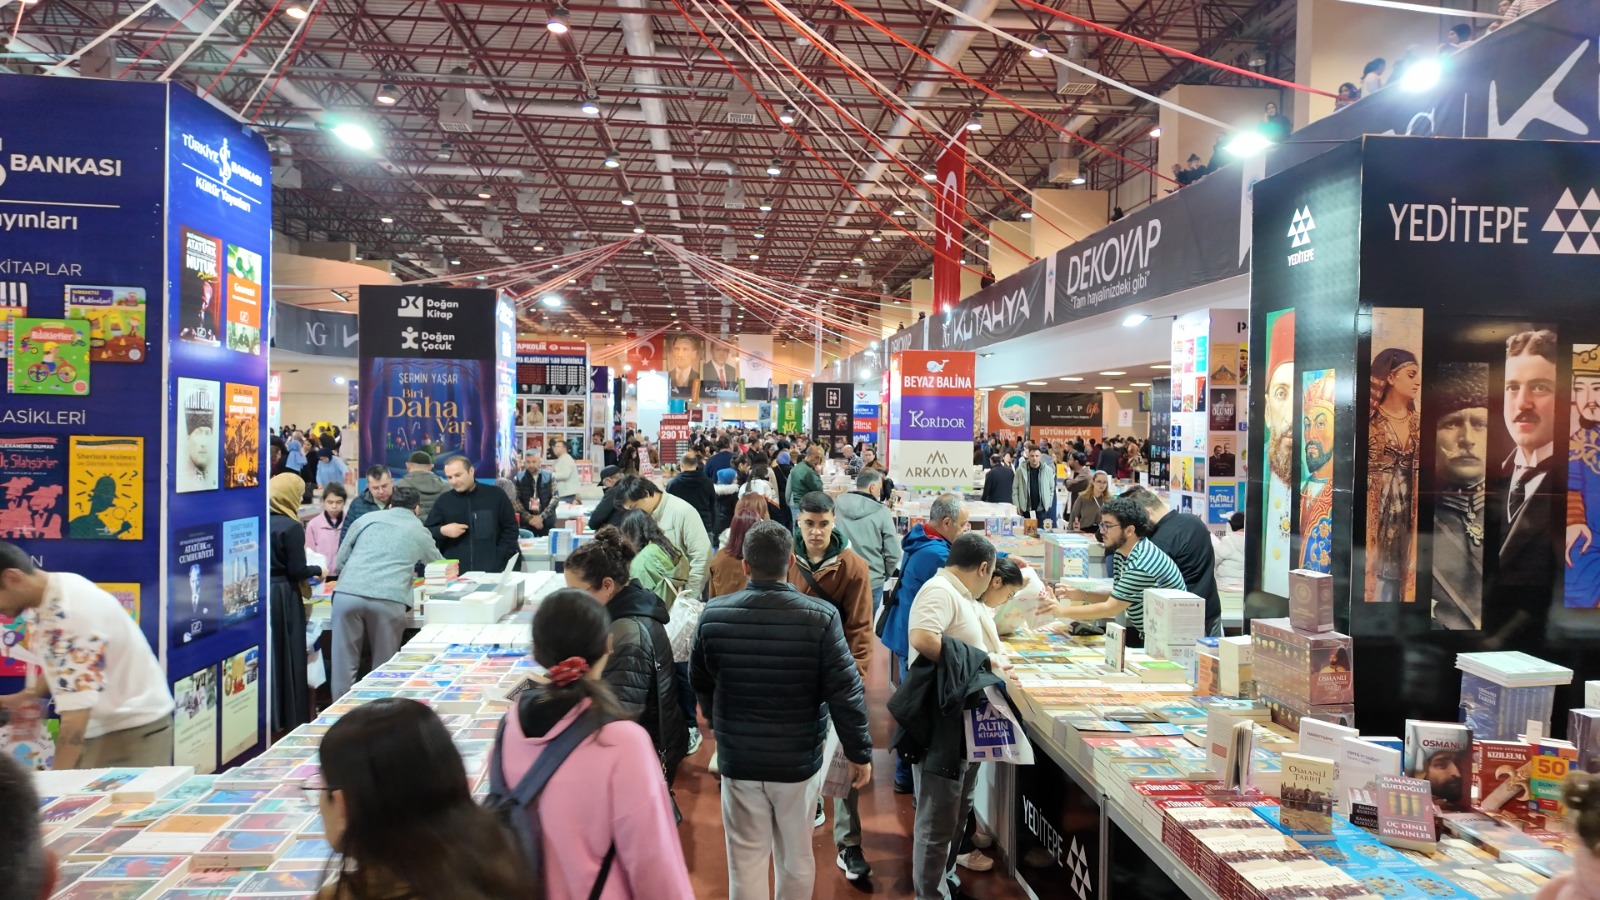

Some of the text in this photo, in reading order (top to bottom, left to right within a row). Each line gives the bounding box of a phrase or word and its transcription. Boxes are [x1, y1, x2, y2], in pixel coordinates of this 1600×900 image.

[182, 134, 219, 163] TÜRKİYE
[10, 153, 122, 176] BANKASI
[0, 210, 78, 231] yınları
[1389, 198, 1529, 244] YEDİTEPE
[1067, 219, 1161, 295] DEKOYAP
[1288, 248, 1315, 266] YEDİTEPE
[186, 254, 217, 277] NUTUK
[1087, 277, 1131, 307] hayalinizdeki
[427, 299, 459, 309] Doğan
[427, 310, 453, 320] Kitap
[954, 287, 1029, 344] KÜTAHYA
[31, 330, 74, 341] Bisikletler
[306, 322, 327, 346] NG
[422, 332, 455, 342] Doğan
[421, 341, 452, 352] Çocuk
[517, 342, 547, 351] APKOLİK
[399, 372, 458, 386] ŞERMİN YAŞAR
[904, 374, 972, 388] BEYAZ BALİNA
[402, 388, 424, 398] Biri
[387, 396, 458, 418] Daha
[1035, 404, 1083, 412] KİTAP
[0, 408, 86, 424] ASİKLERİ
[436, 417, 472, 434] Var
[661, 431, 688, 439] 290 TL
[1040, 428, 1064, 436] BÜTÜN
[905, 467, 968, 478] ARKADYA
[184, 542, 207, 554] ATATÜRK
[179, 548, 214, 564] CUMHURİYETİ
[1318, 674, 1347, 682] OSMANLI
[978, 721, 1009, 731] ALTIN
[978, 730, 1010, 739] KİTAPLAR
[1423, 739, 1466, 749] OSMANLI
[1487, 751, 1527, 760] KIZILELMA
[1289, 765, 1326, 778] OSMANLI
[1538, 758, 1566, 777] 50
[1383, 776, 1424, 786] RAMAZAN
[1381, 783, 1427, 794] KURTOĞLU
[1023, 795, 1063, 868] YEDİTEPE
[1386, 820, 1427, 831] ÜÇ DİNLİ
[1383, 828, 1432, 840] MÜMİNLER
